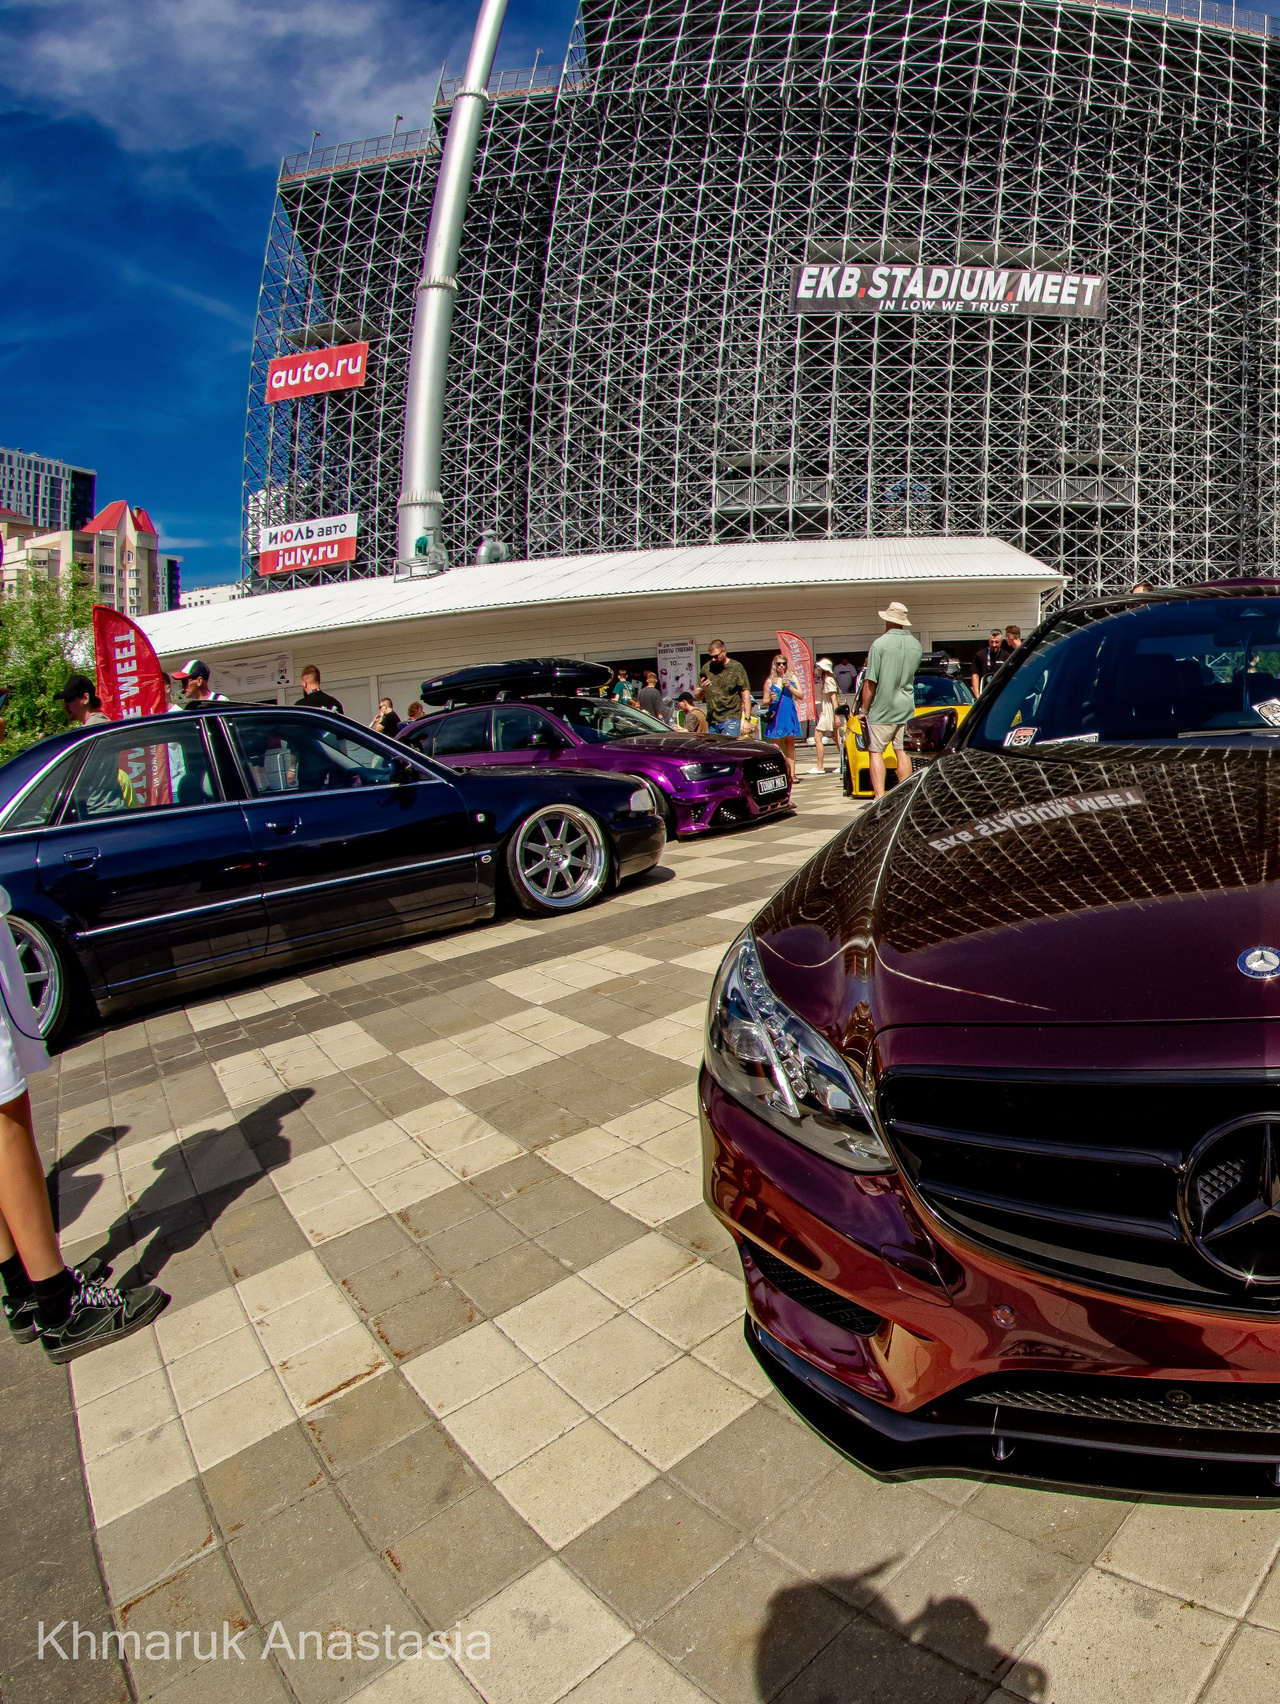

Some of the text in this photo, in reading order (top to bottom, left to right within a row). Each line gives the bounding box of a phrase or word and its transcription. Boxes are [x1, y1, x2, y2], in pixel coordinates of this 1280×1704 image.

[878, 300, 1019, 313] IN LOW WE TRUST
[271, 355, 362, 389] auto.ru
[268, 523, 347, 545] ИЮЛЬ авто
[275, 543, 339, 571] july.ru
